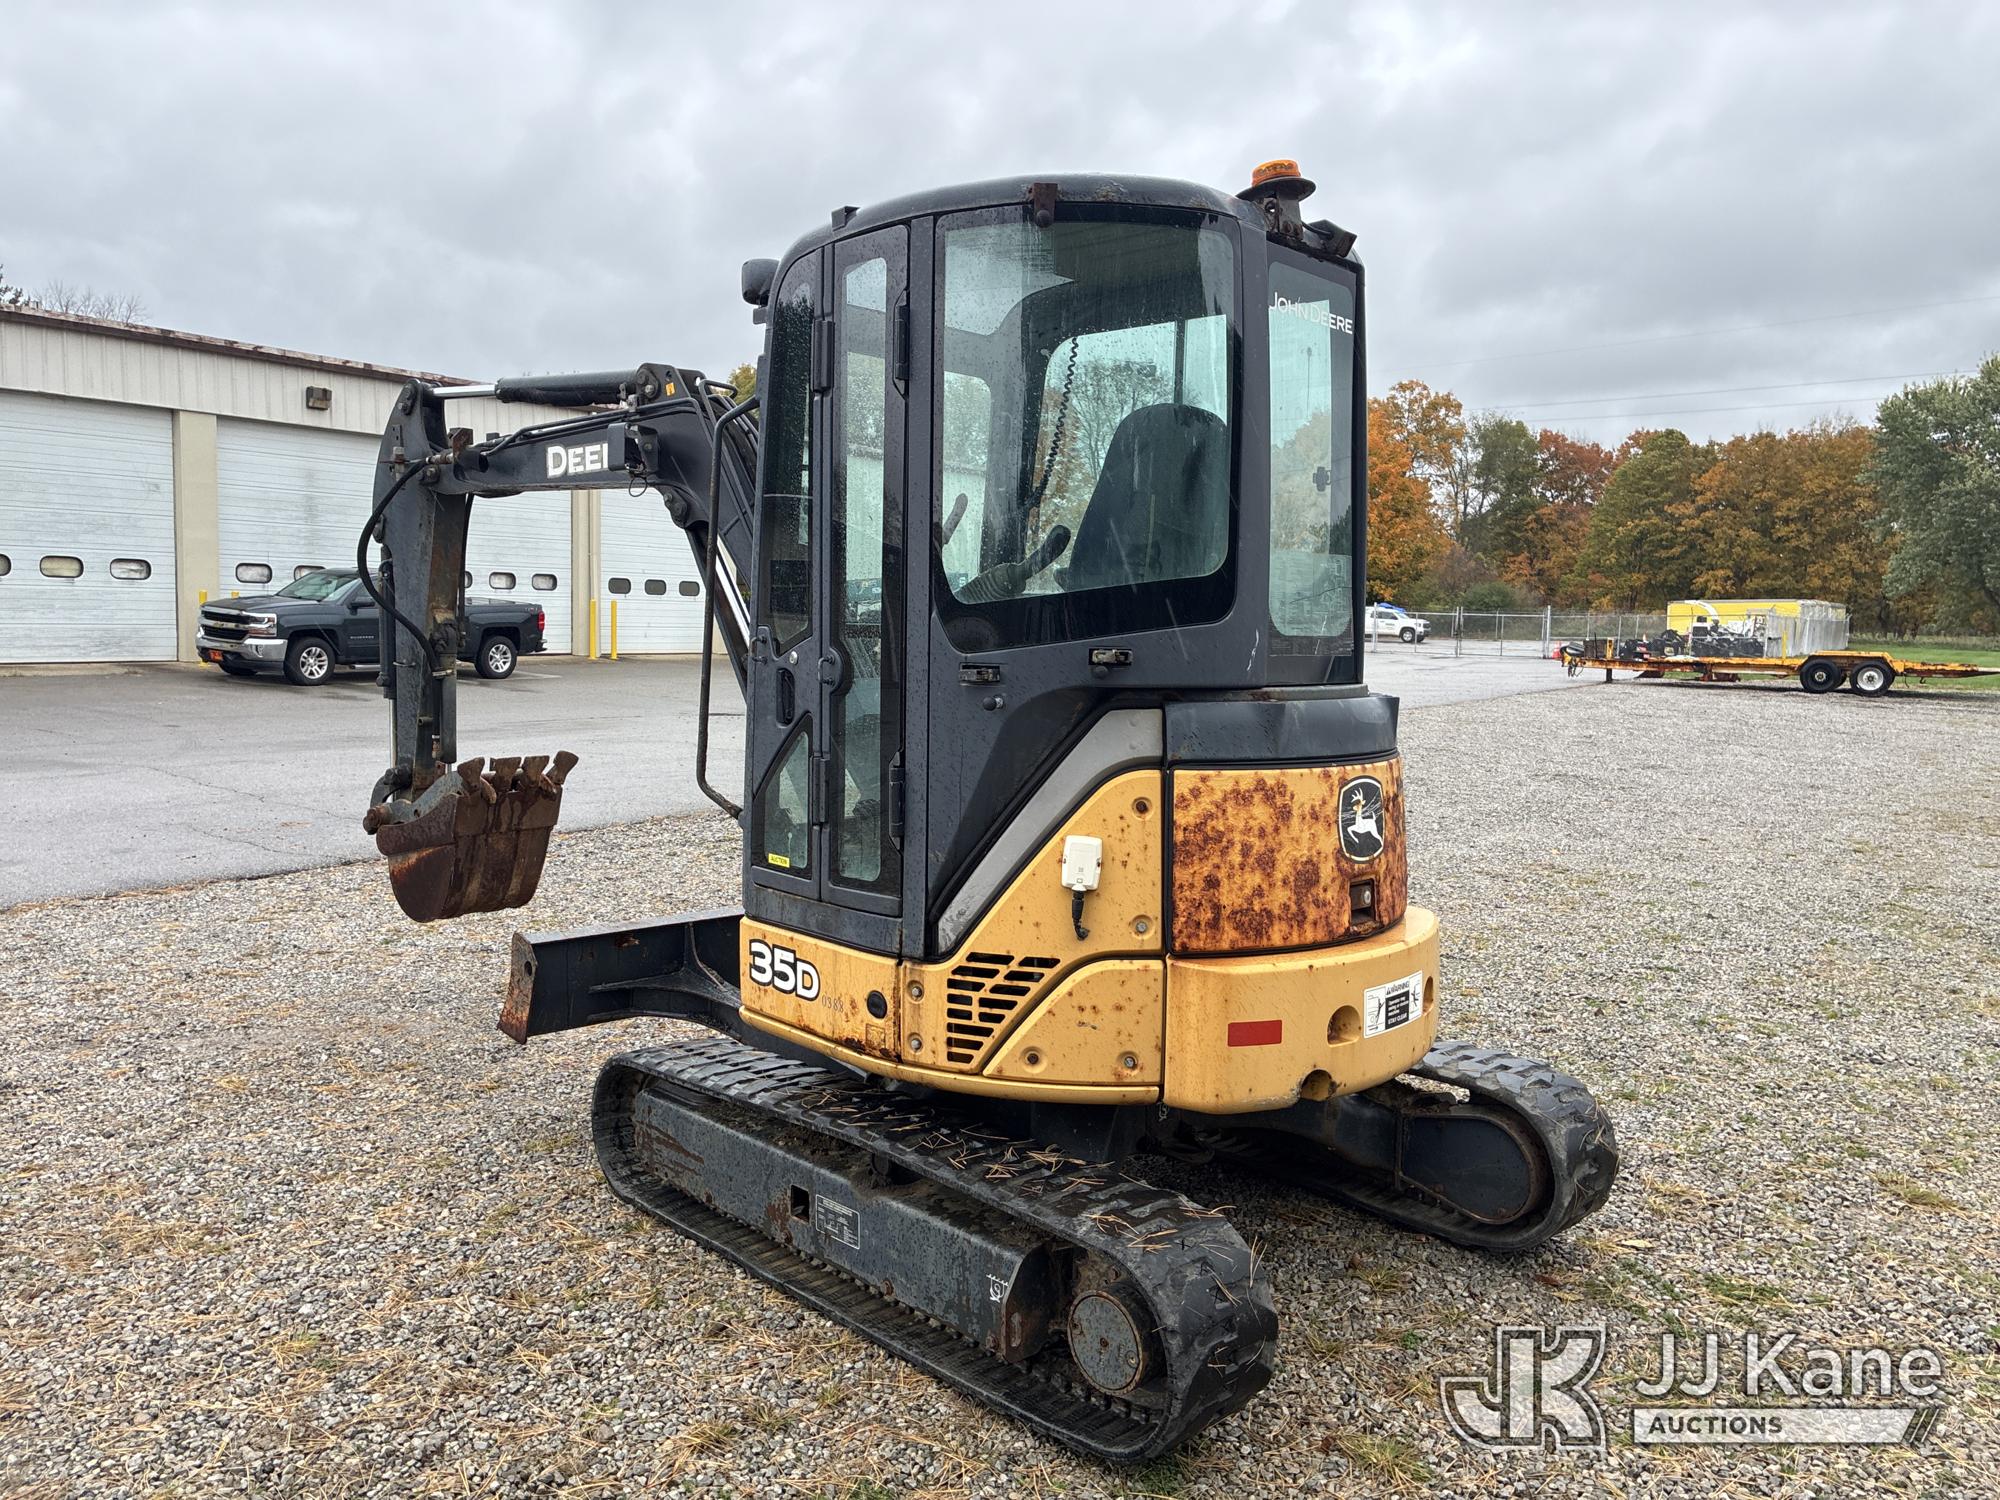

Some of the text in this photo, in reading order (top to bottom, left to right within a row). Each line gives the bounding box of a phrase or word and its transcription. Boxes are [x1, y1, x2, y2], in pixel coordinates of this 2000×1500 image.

[1269, 291, 1353, 335] JOHN DEERE
[750, 939, 820, 1001] 35D
